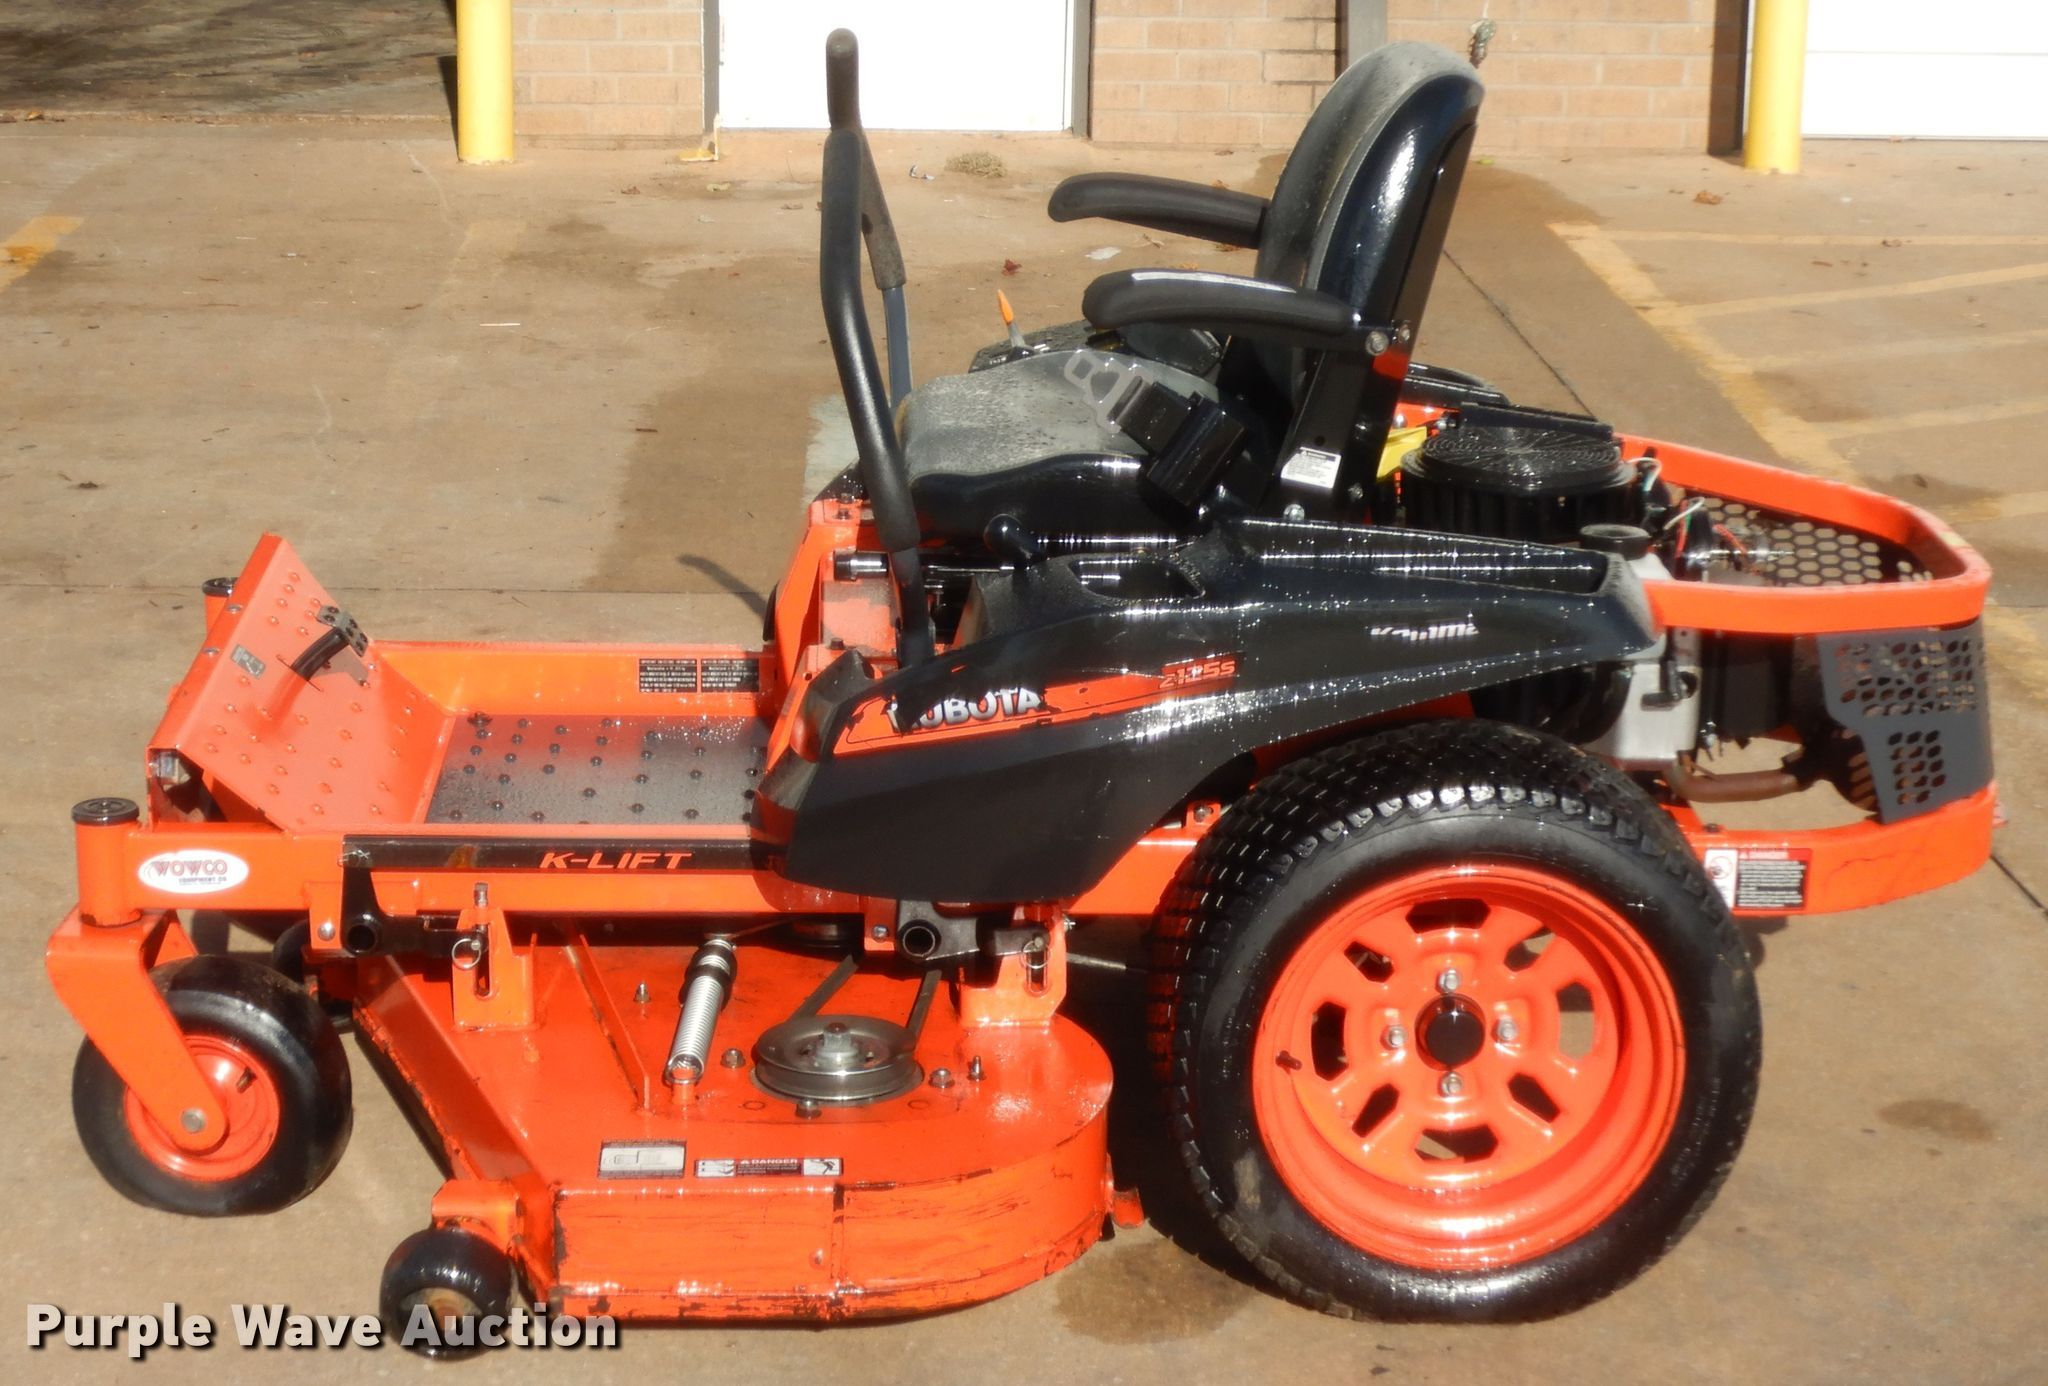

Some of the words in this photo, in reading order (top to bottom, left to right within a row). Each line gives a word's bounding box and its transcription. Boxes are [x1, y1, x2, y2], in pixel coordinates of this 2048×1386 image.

[886, 687, 1041, 732] UBOTA
[150, 859, 228, 876] WOWCO
[539, 852, 692, 869] K-LIFT
